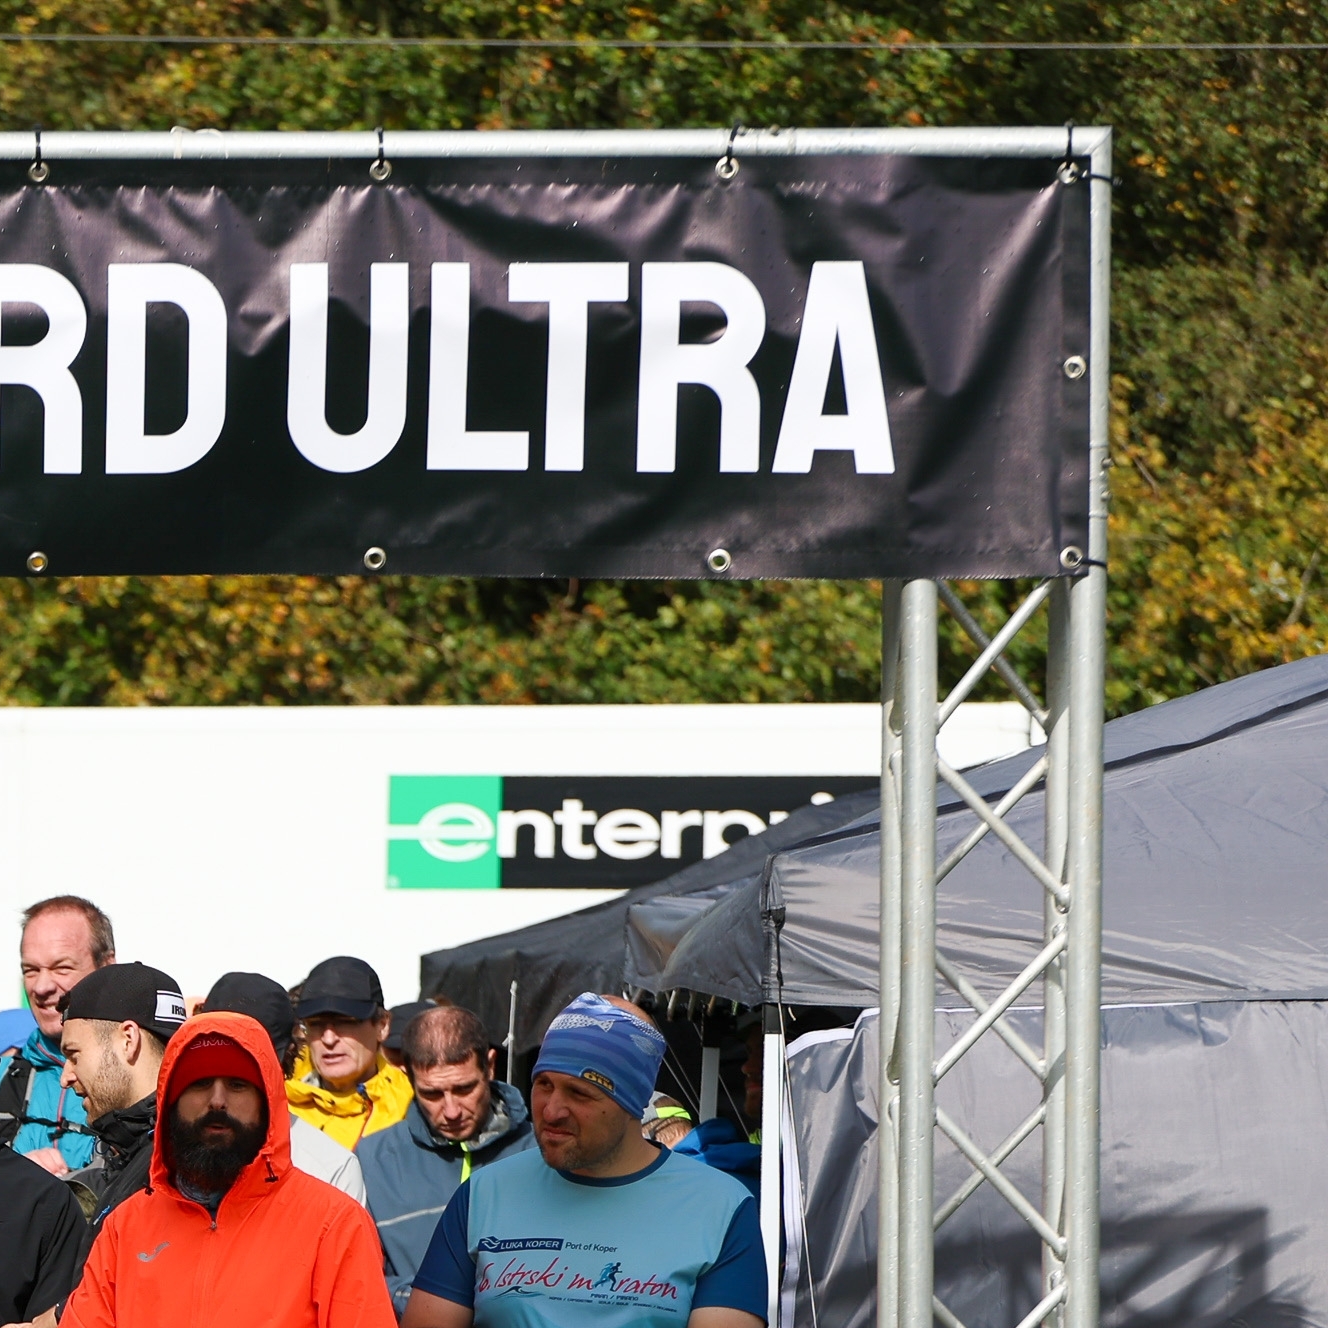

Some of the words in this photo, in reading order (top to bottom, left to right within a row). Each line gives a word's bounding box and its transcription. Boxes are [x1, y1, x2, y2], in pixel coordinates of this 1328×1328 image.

[288, 259, 894, 475] ULTRA
[417, 792, 834, 861] enterp
[500, 1241, 523, 1250] LUKA
[525, 1240, 560, 1249] KOPER
[565, 1241, 581, 1251] Port
[582, 1243, 592, 1251] of
[593, 1244, 618, 1253] Koper
[494, 1257, 569, 1288] Istrski
